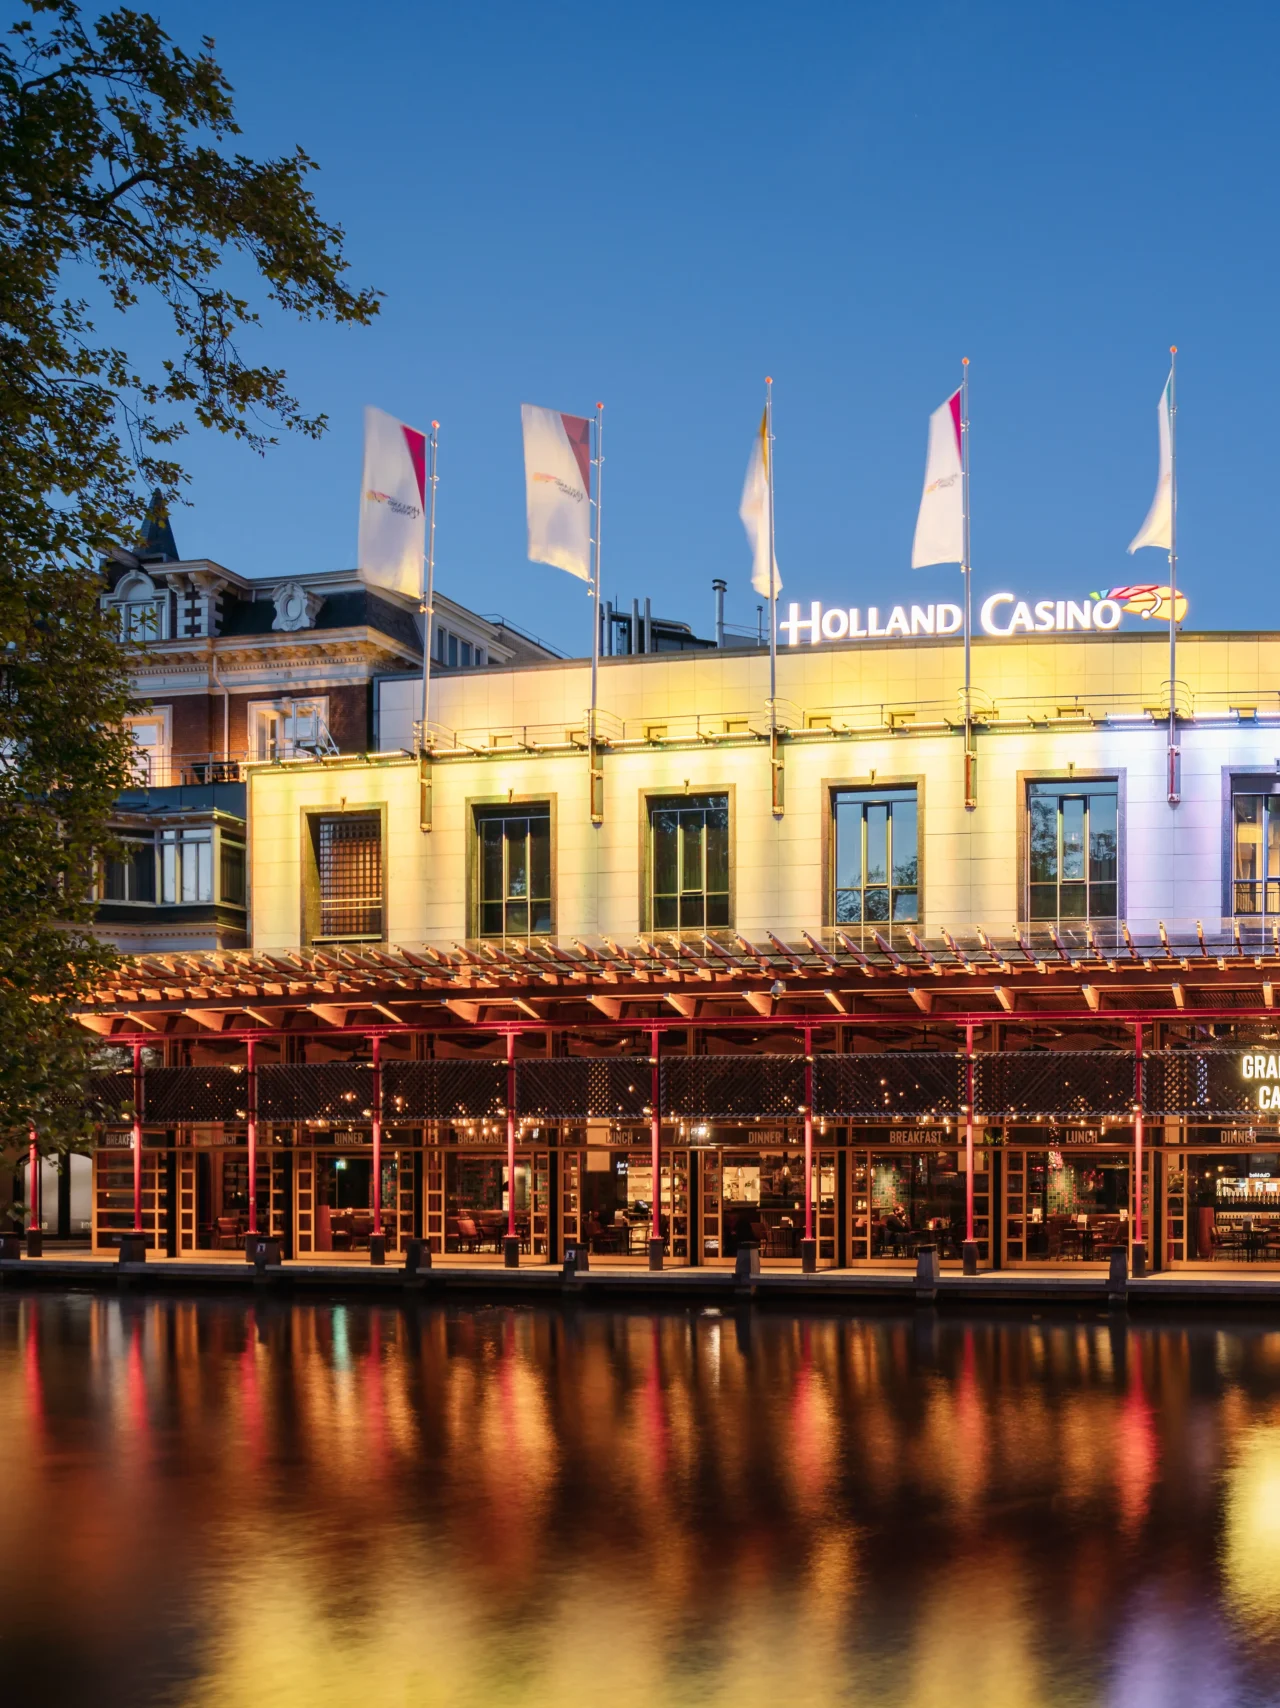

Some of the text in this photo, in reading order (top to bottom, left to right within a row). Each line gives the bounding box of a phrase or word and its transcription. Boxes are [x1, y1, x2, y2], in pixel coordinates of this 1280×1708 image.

[780, 592, 1122, 646] HOLLAND CASINO
[106, 1133, 136, 1145] BREAKFA
[334, 1132, 363, 1145] DINNER
[457, 1132, 504, 1144] BREAKFAST
[605, 1132, 633, 1144] LUNCH
[748, 1132, 782, 1144] DINNER
[889, 1131, 943, 1143] BREAKFAST
[1065, 1131, 1098, 1143] LUNCH
[1220, 1130, 1257, 1144] DINNER
